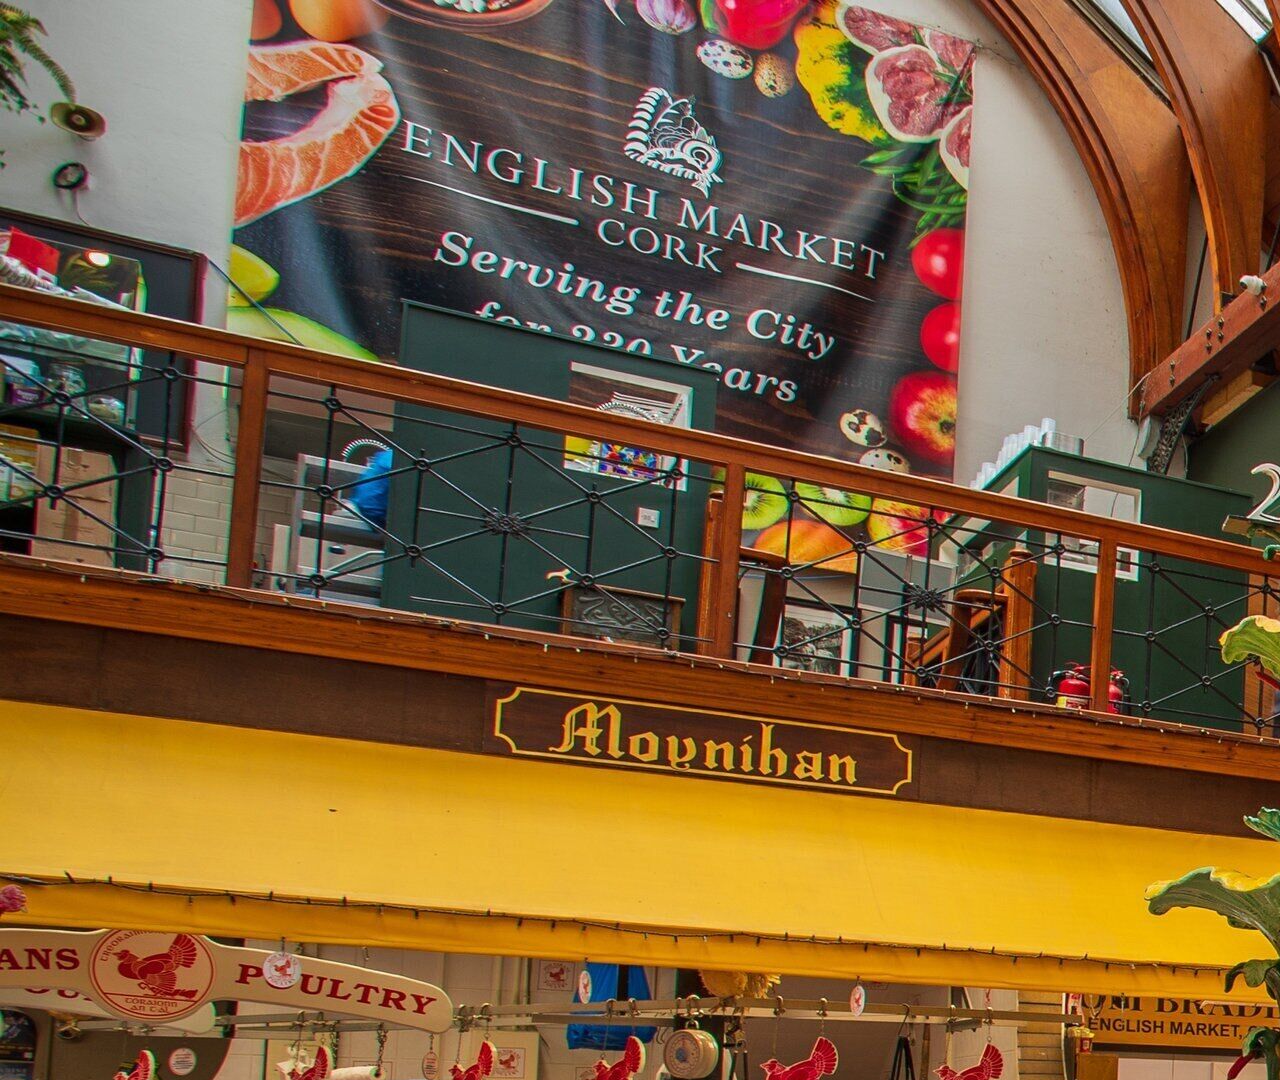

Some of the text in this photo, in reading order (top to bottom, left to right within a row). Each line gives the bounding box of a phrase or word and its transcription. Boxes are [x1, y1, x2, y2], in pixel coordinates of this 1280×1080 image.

[400, 119, 885, 279] ENGLISH MARKET
[597, 219, 723, 274] CORK
[434, 231, 836, 361] Serving the City
[549, 702, 857, 784] Moynihan
[1088, 1017, 1165, 1034] ENGLISH
[1170, 1021, 1243, 1038] MARKET,
